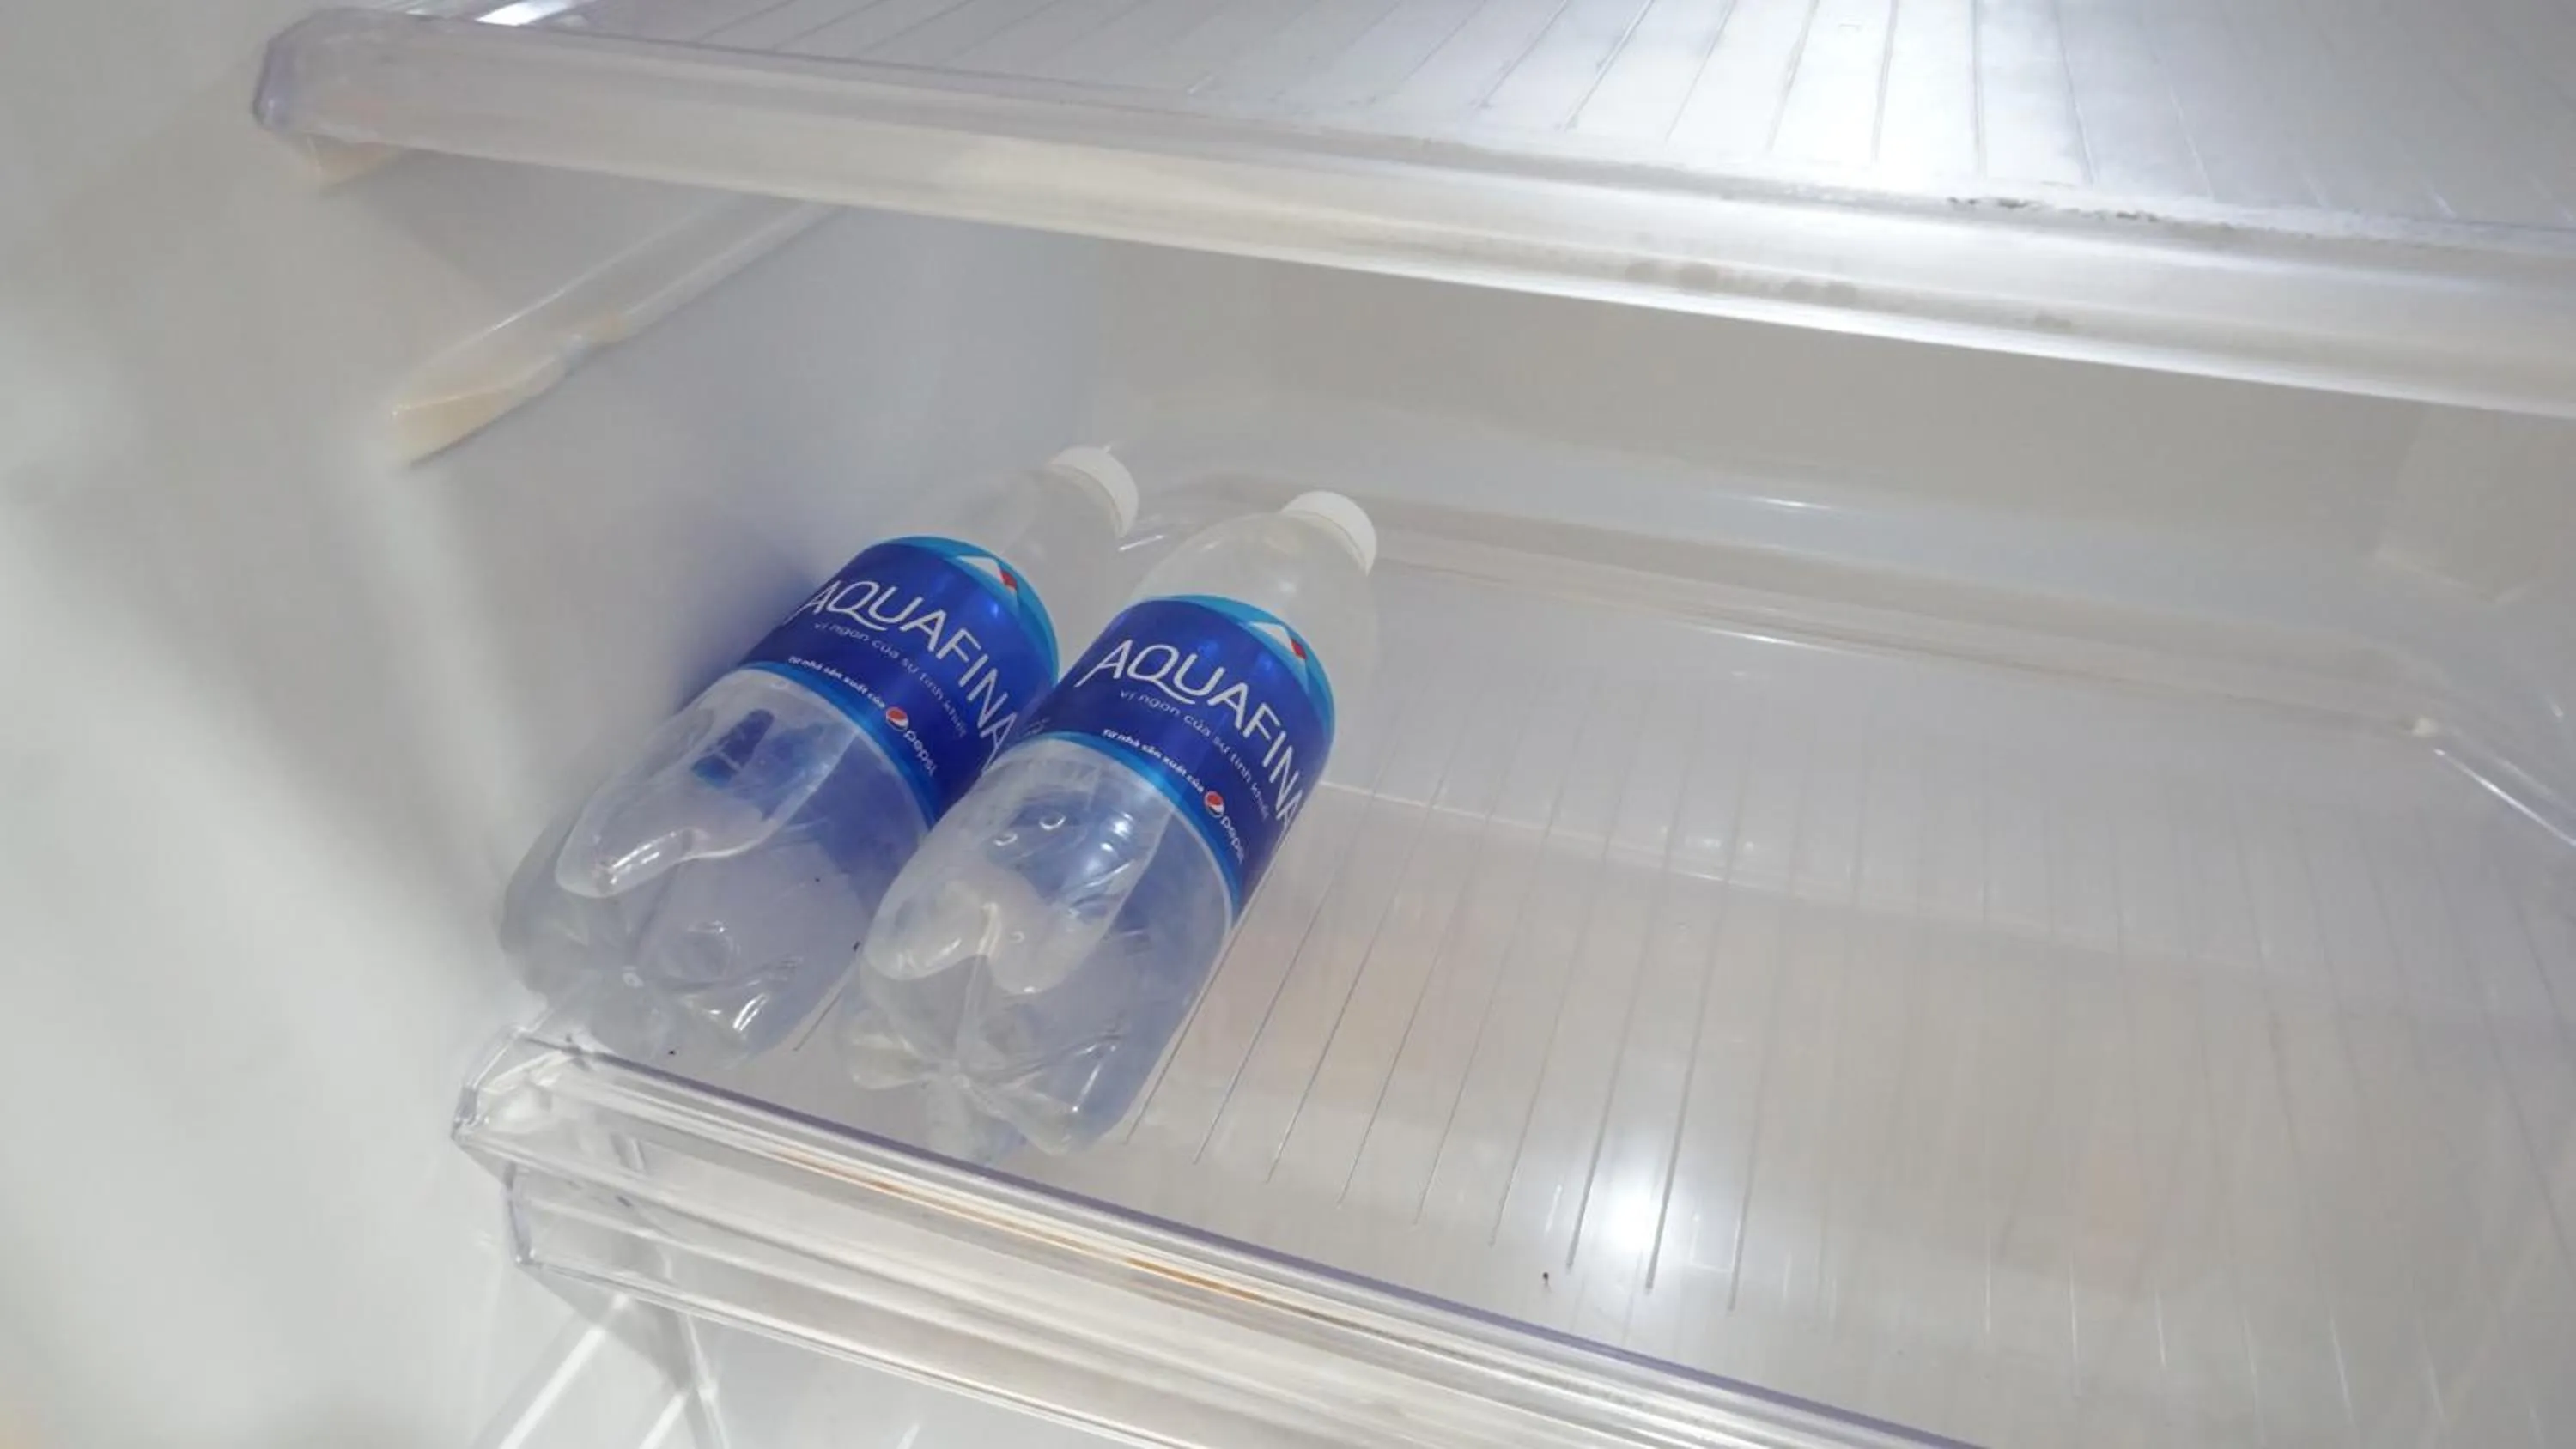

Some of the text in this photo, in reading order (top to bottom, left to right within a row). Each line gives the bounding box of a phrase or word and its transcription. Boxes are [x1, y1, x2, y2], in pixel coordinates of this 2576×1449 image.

[783, 579, 1018, 773] AQUAFINA
[1138, 694, 1181, 716] ngon
[903, 730, 938, 776] pepsi
[1073, 639, 1303, 840] AQUAFINA
